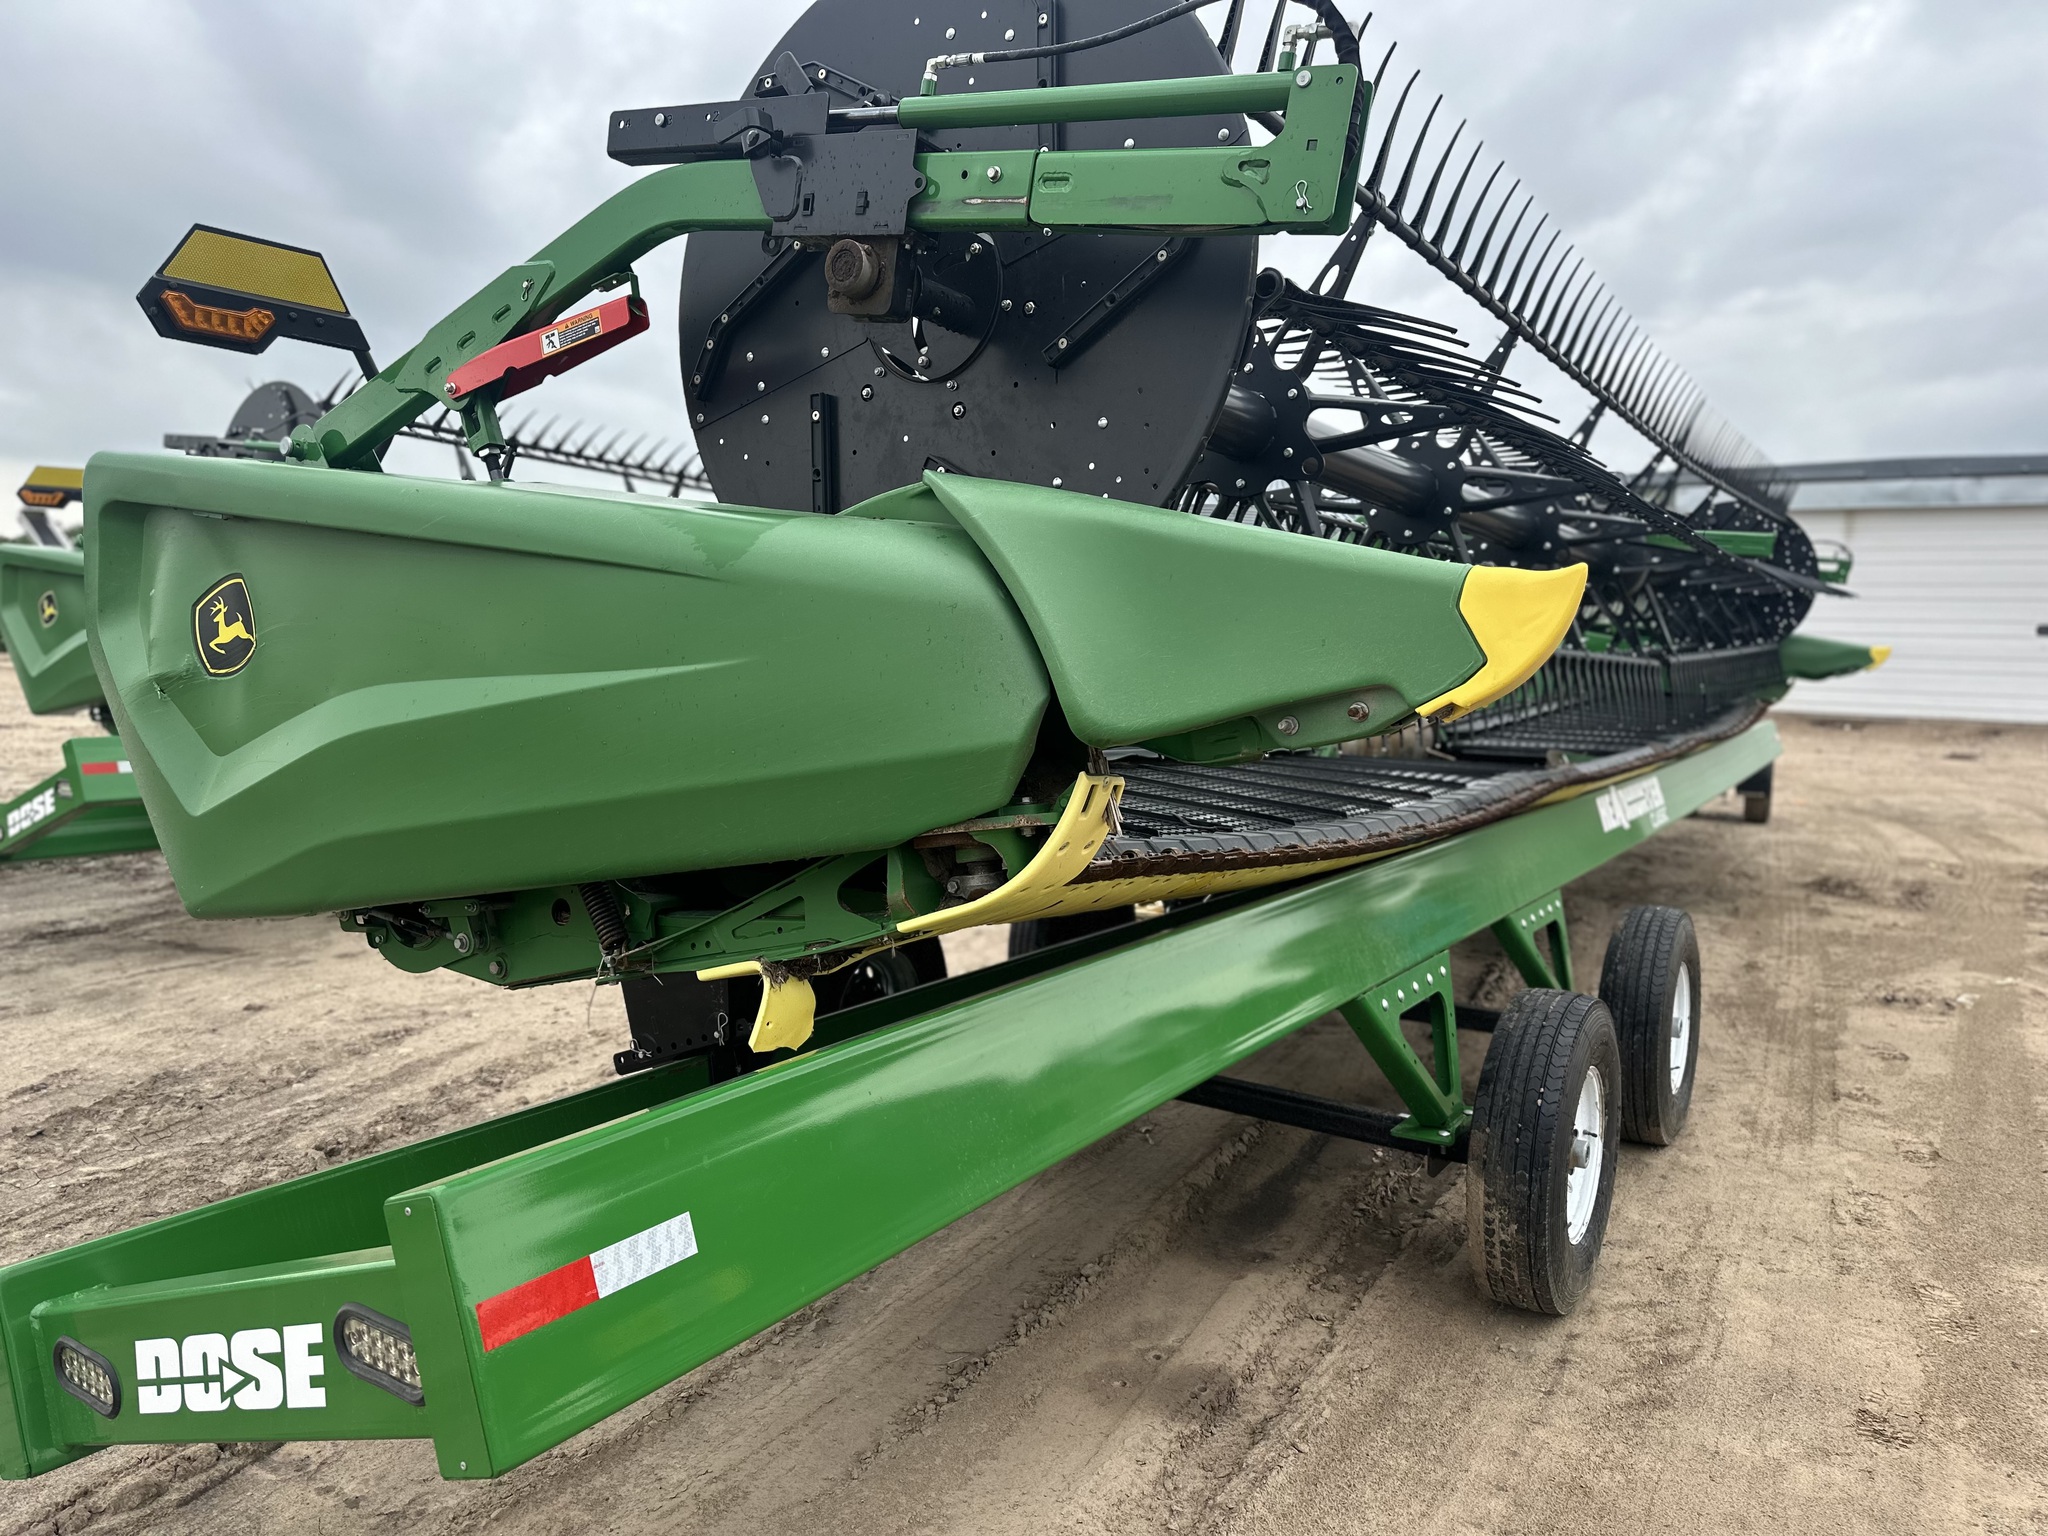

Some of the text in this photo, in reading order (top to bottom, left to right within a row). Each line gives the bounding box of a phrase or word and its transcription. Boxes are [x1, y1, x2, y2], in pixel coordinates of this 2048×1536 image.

[712, 110, 720, 122] 2
[570, 313, 594, 327] WARNING
[135, 1323, 327, 1414] DOSE
